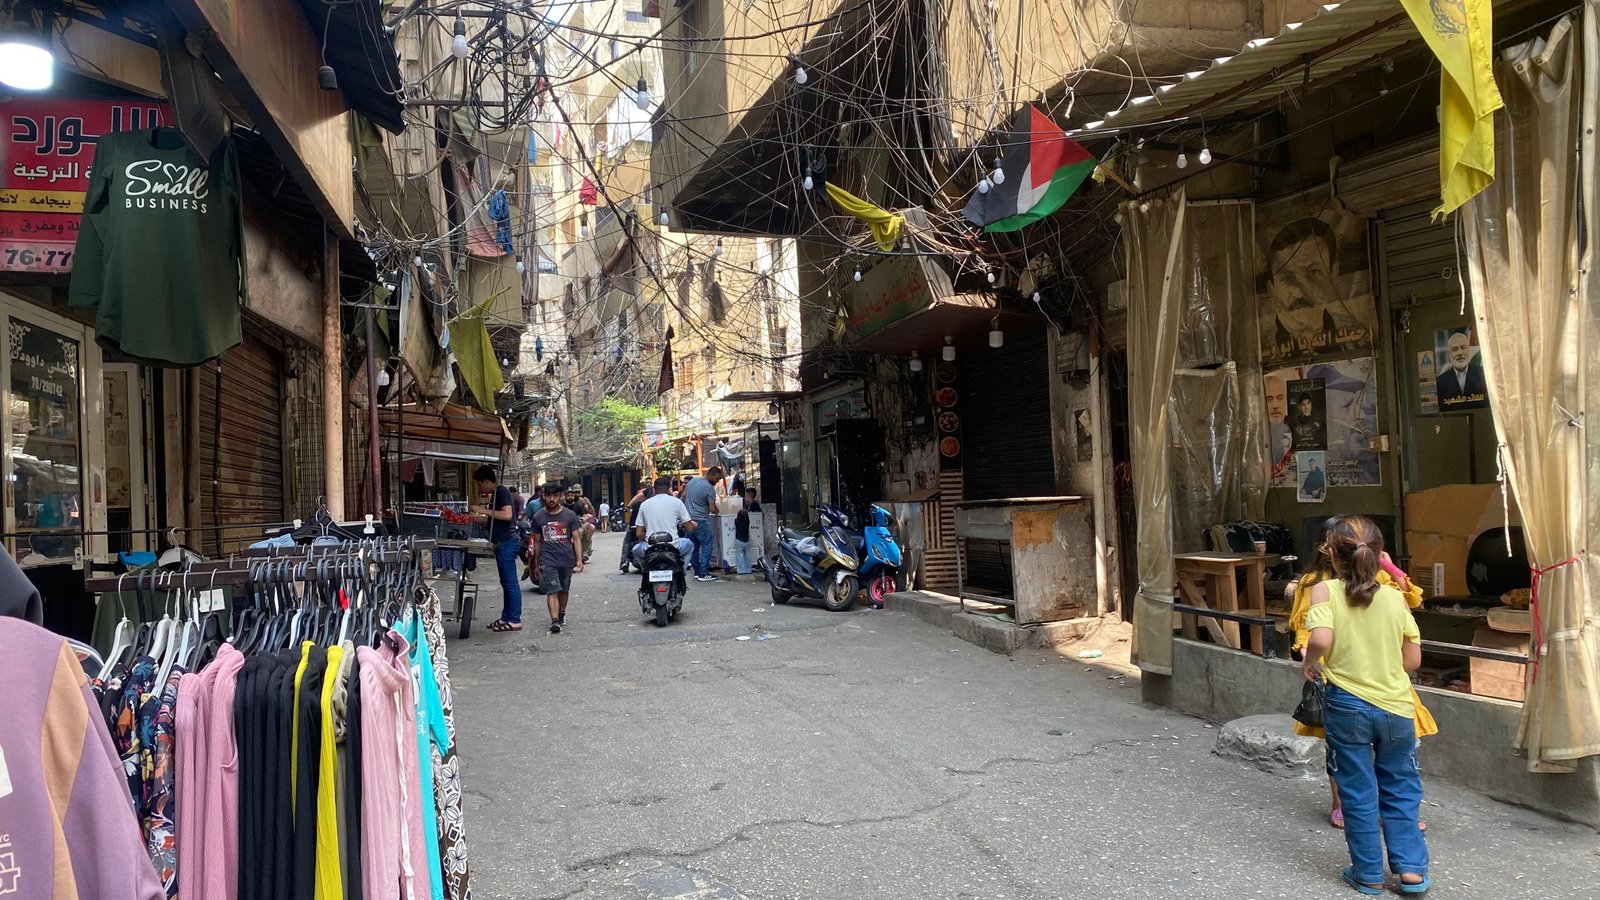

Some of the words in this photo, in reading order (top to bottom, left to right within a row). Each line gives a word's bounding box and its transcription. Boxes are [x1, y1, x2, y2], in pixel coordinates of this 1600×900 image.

[13, 162, 78, 183] التركية
[125, 159, 209, 199] Small
[29, 196, 71, 208] بيجامه
[125, 197, 207, 213] BUSINESS
[20, 219, 64, 234] ومفرق
[5, 248, 74, 267] 76-77
[1311, 328, 1332, 347] الله
